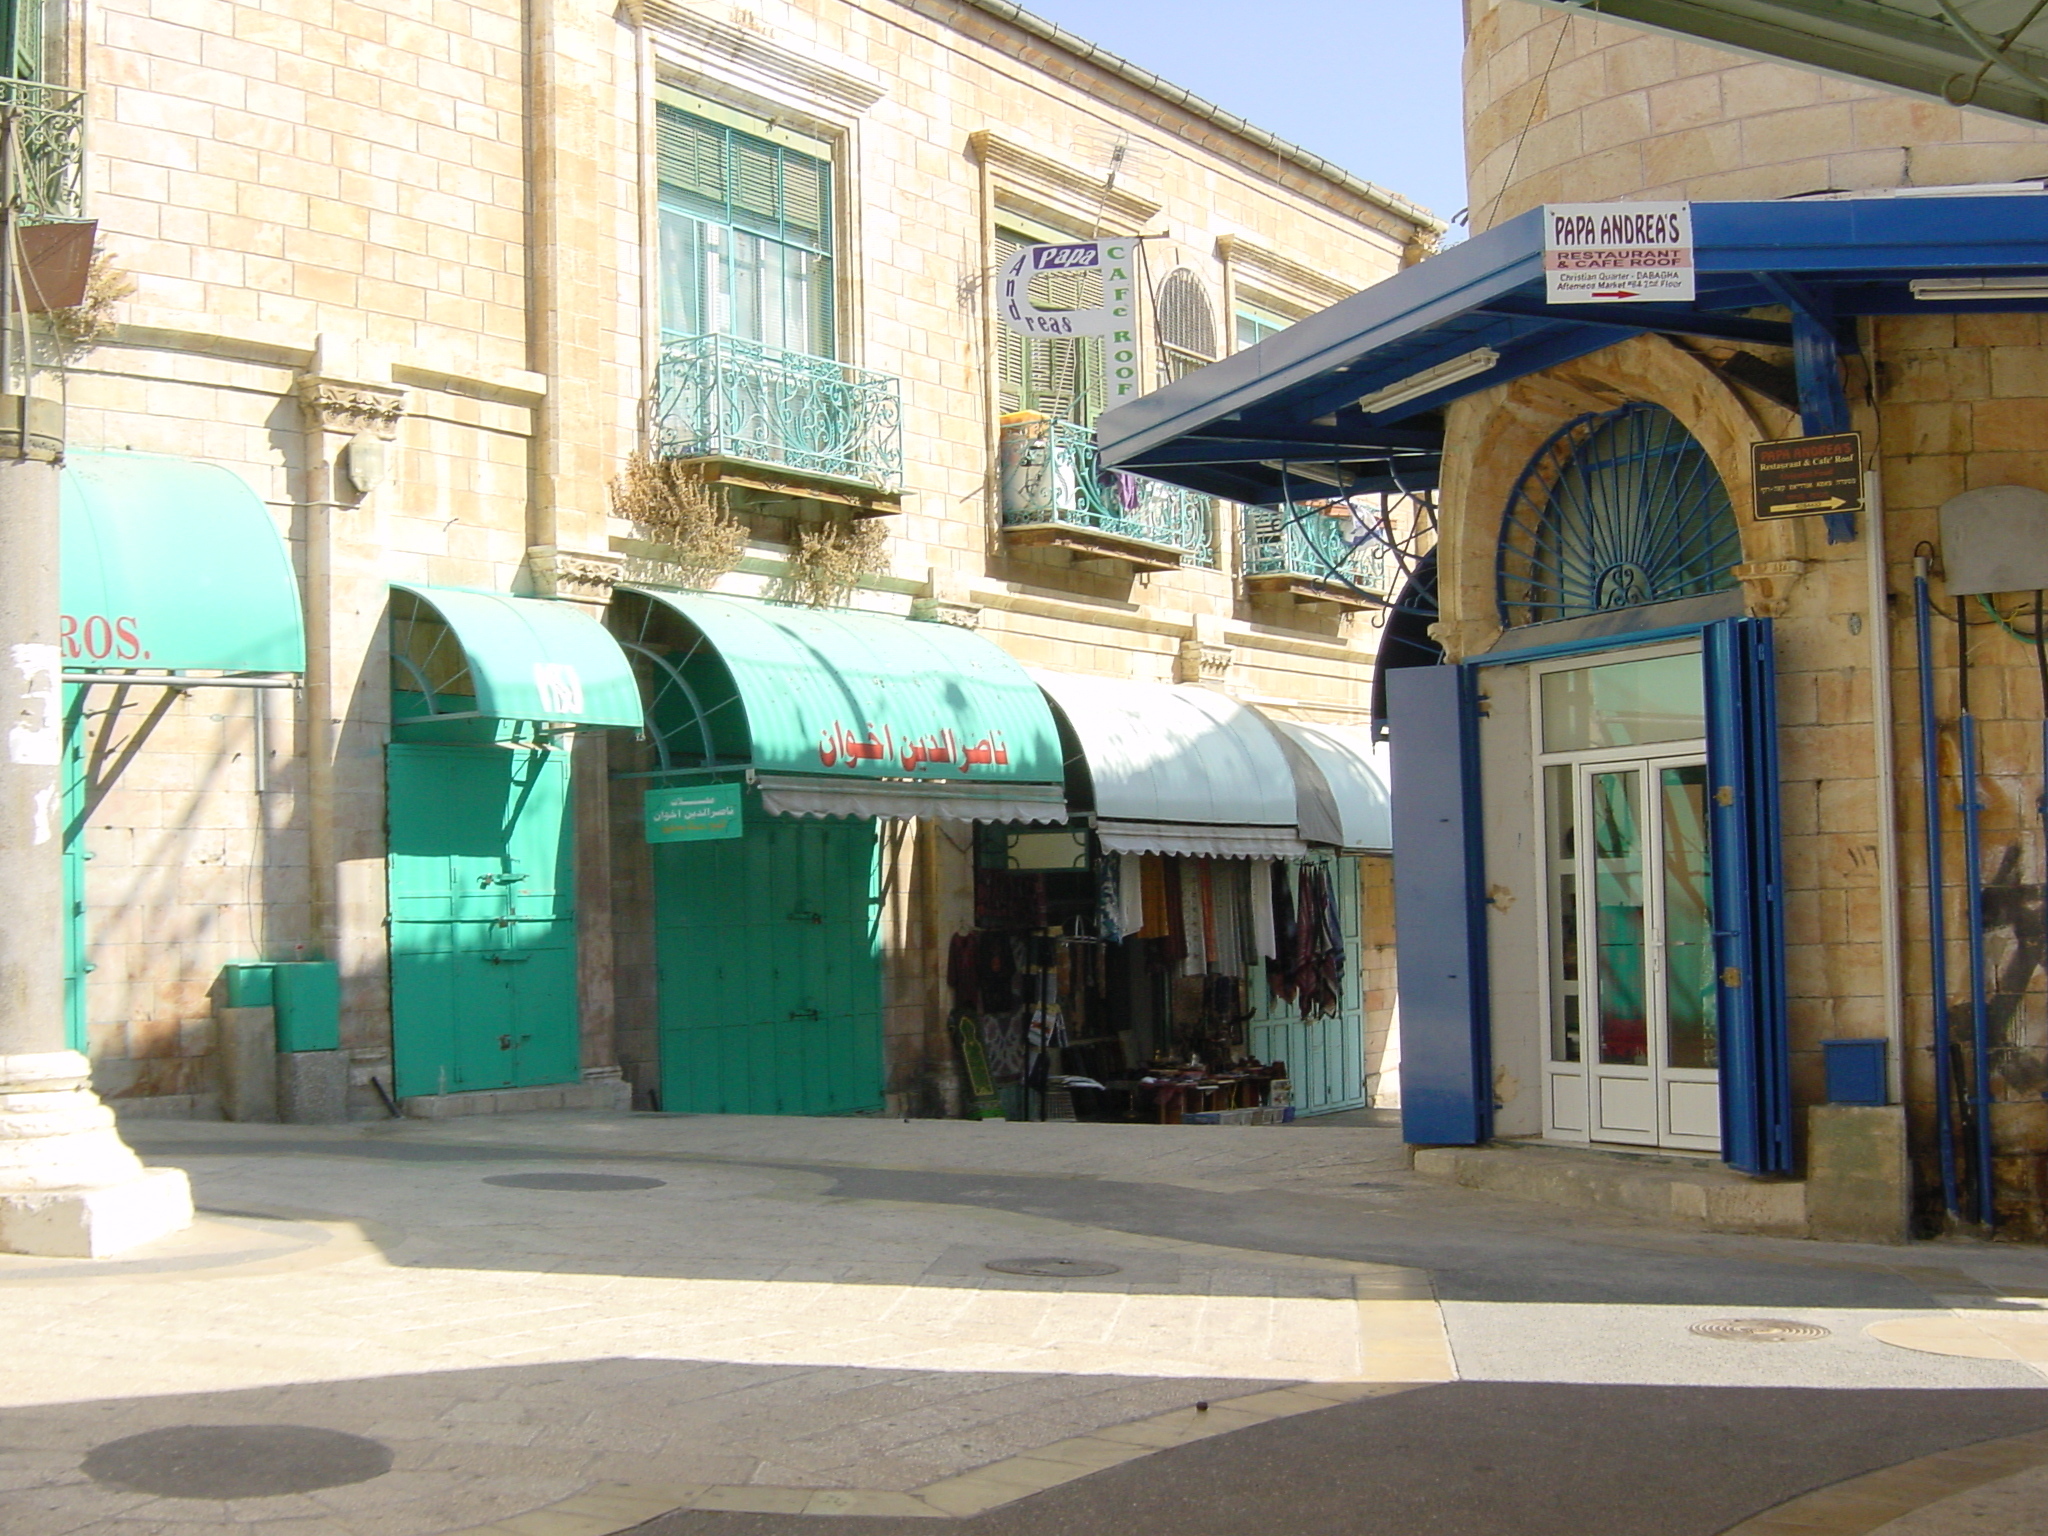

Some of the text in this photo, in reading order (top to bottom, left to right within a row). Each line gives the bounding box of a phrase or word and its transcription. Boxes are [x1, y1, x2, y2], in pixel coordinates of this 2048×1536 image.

[1555, 213, 1680, 245] PAPA ANDREA'S
[1557, 250, 1682, 260] RESTAURANT
[1557, 258, 1682, 268] & CAFE ROOF
[1560, 273, 1597, 281] Christian
[1599, 272, 1630, 280] Quarter
[1598, 281, 1626, 289] Market
[1660, 280, 1682, 288] Floor
[1005, 247, 1097, 335] Papa Andreas
[1113, 330, 1134, 396] ROOF
[1760, 449, 1791, 462] PAPA
[1835, 454, 1854, 463] Roof
